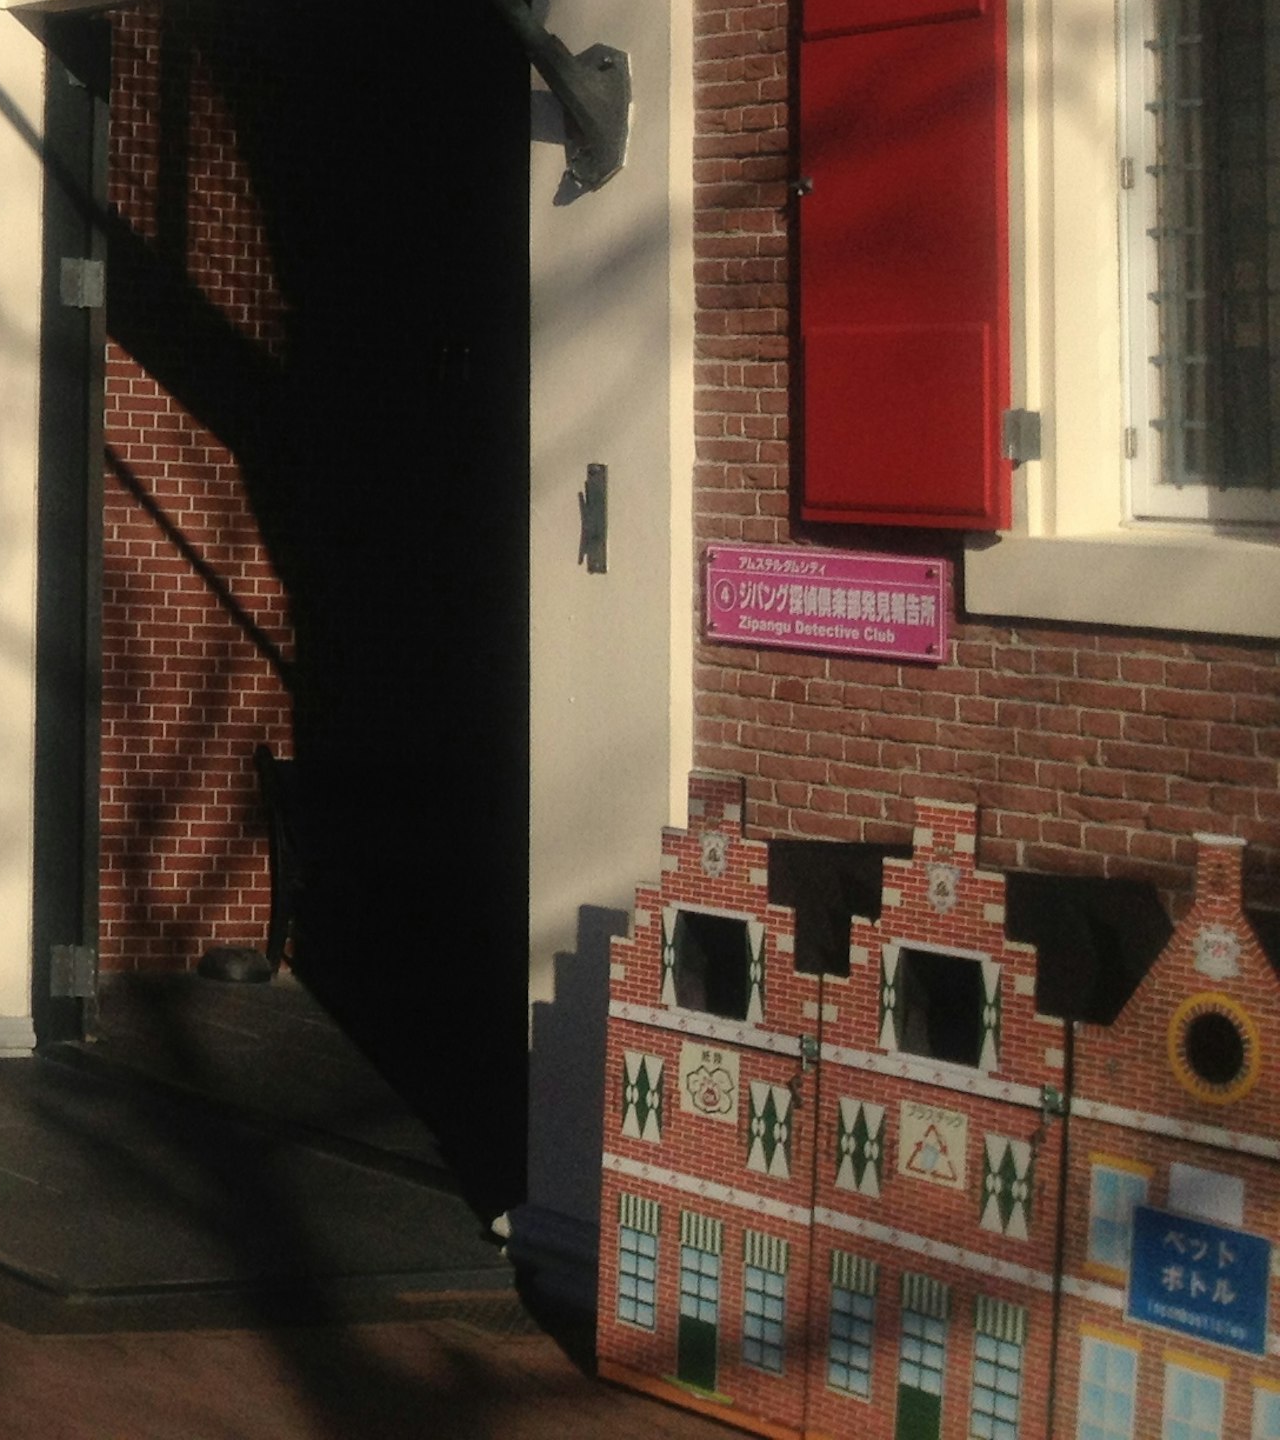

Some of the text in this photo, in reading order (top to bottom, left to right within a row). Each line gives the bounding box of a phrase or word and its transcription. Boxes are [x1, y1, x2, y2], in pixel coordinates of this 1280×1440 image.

[738, 556, 827, 576] アムステルダムシティ
[739, 615, 895, 643] Zipangu Detective Club
